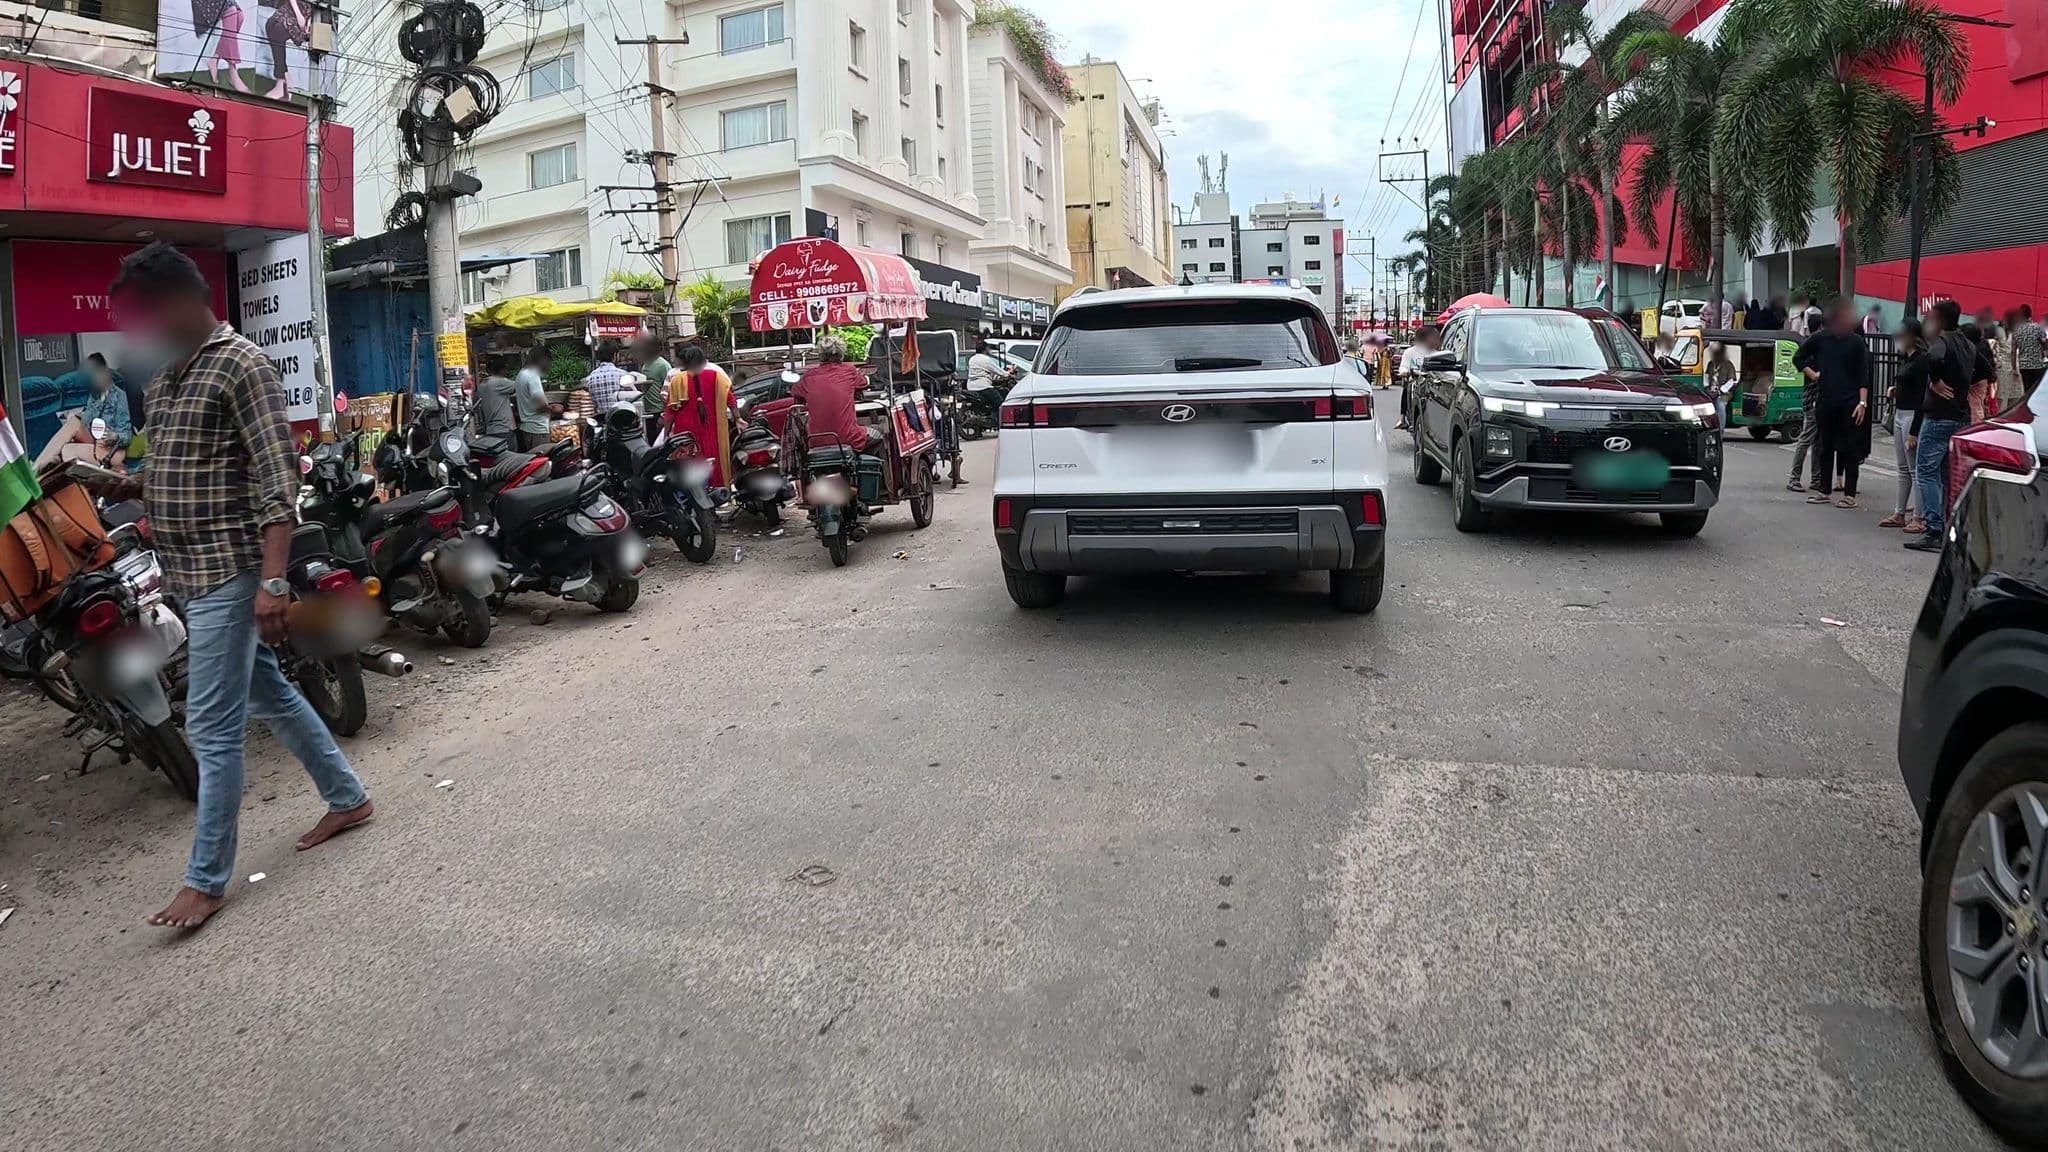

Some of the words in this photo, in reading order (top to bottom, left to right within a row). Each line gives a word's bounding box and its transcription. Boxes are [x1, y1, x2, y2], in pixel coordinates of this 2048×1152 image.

[107, 132, 212, 177] JULIET
[241, 271, 259, 289] BED
[261, 257, 298, 285] SHEETS
[773, 262, 806, 280] Dairy
[808, 259, 840, 278] Fudge
[759, 289, 787, 302] CELL
[796, 281, 859, 298] 9908669572
[243, 294, 279, 320] TOWELS
[24, 341, 43, 361] LONG
[302, 386, 313, 405] @
